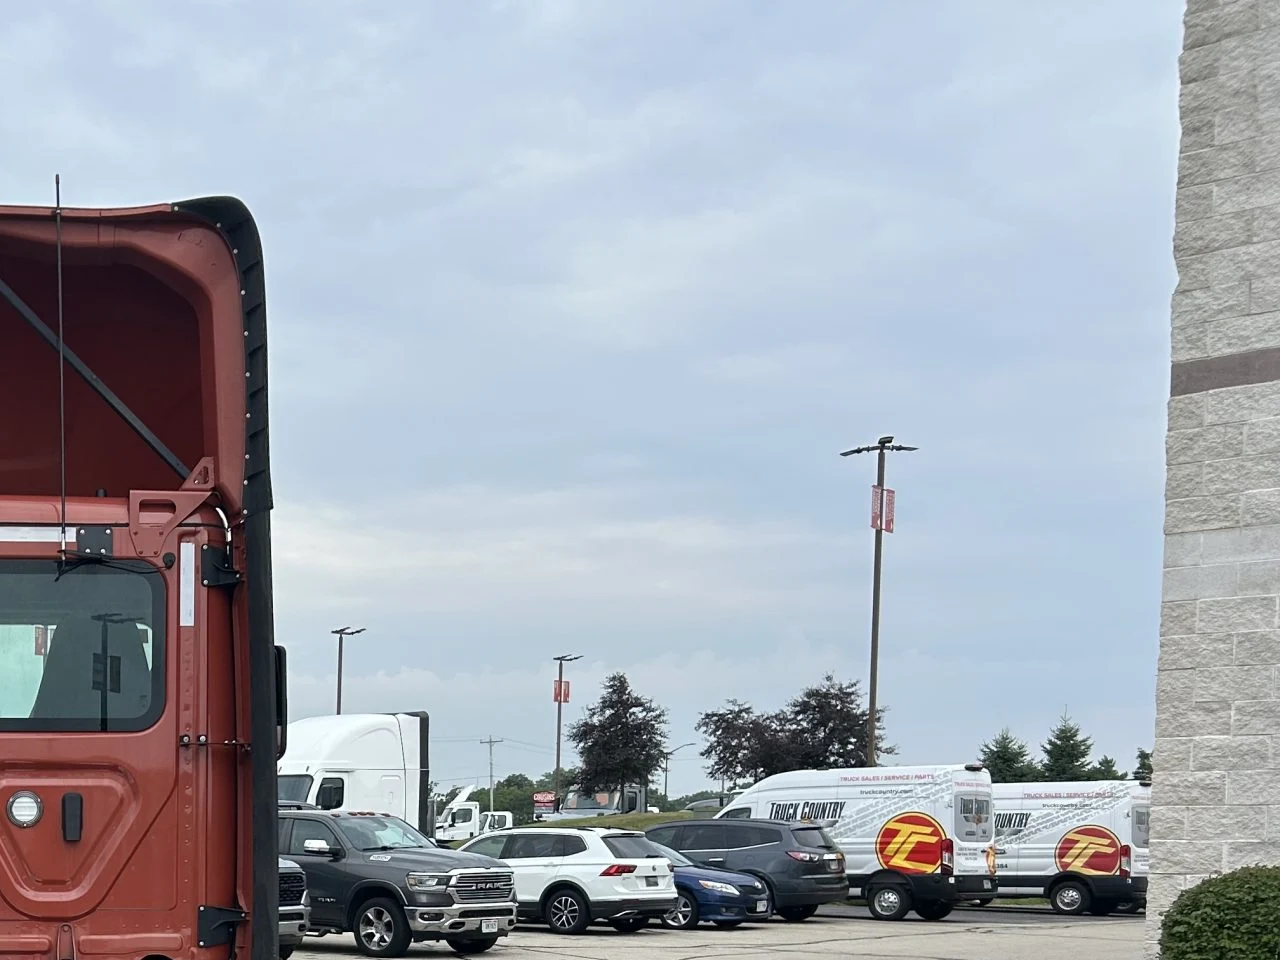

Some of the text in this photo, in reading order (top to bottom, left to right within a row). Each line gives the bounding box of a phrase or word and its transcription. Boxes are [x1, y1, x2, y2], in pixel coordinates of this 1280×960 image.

[769, 801, 846, 820] TRUCK COUNTRY
[994, 812, 1031, 829] OUNTRY
